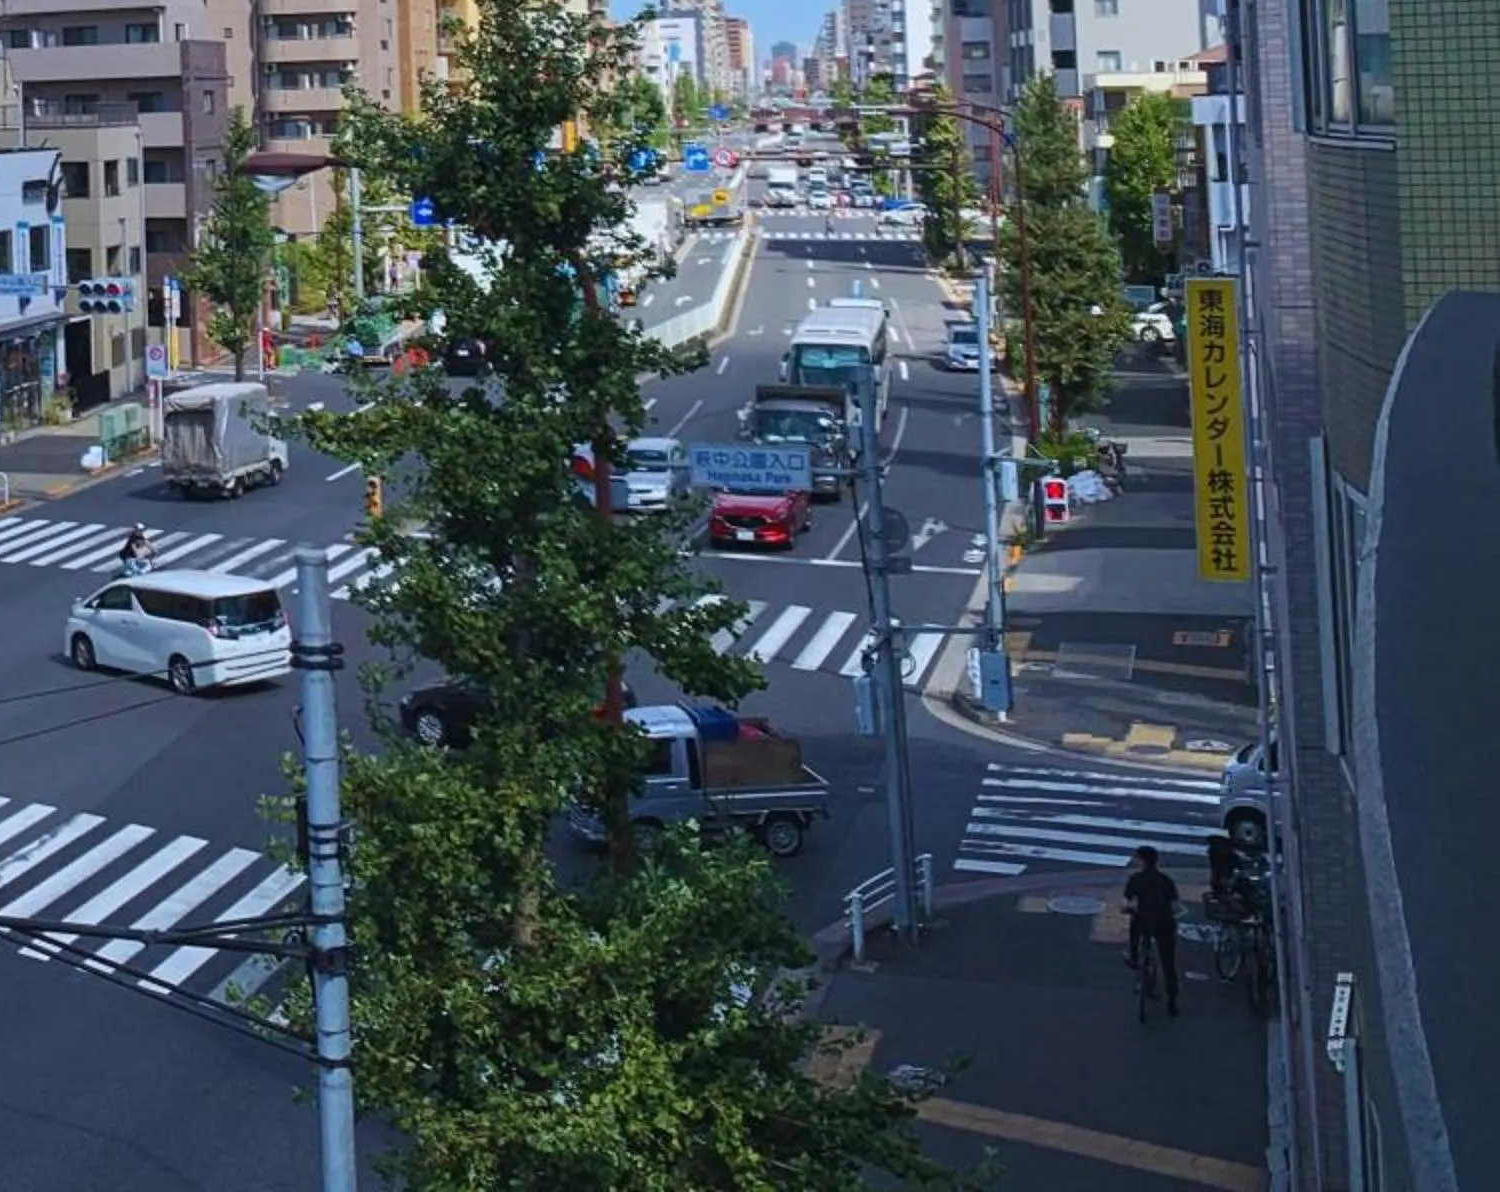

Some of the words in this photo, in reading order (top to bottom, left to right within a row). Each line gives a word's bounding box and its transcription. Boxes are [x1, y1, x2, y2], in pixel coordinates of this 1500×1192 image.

[1198, 289, 1239, 572] 東海カレンダー株式会社
